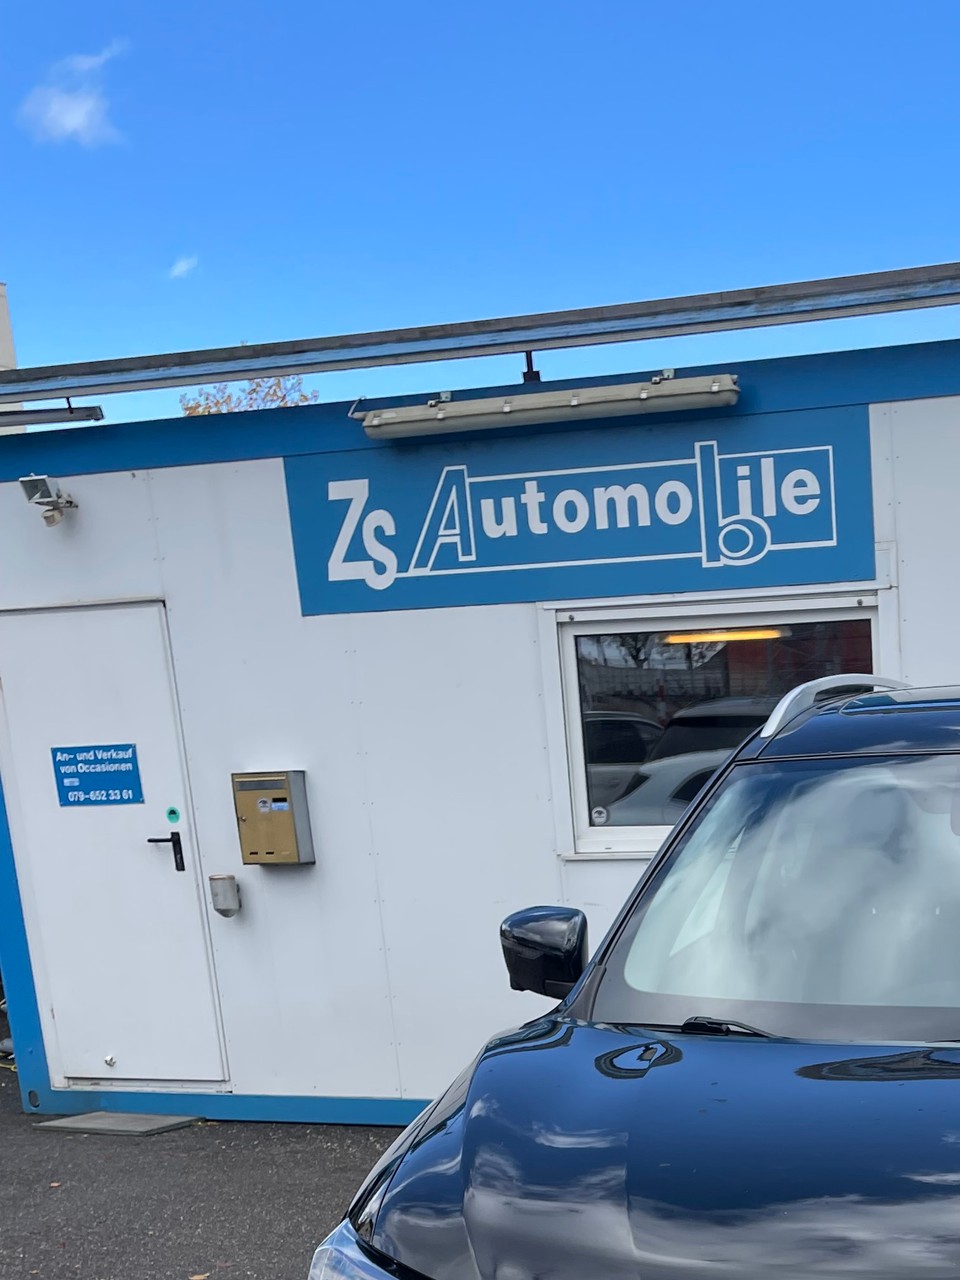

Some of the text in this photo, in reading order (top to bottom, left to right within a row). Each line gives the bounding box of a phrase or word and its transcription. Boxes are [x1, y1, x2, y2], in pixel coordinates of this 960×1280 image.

[327, 440, 822, 591] Zs Automobile
[76, 750, 94, 760] und
[95, 748, 133, 760] Verkauf
[60, 761, 133, 773] von Occasionen
[108, 789, 121, 800] 33
